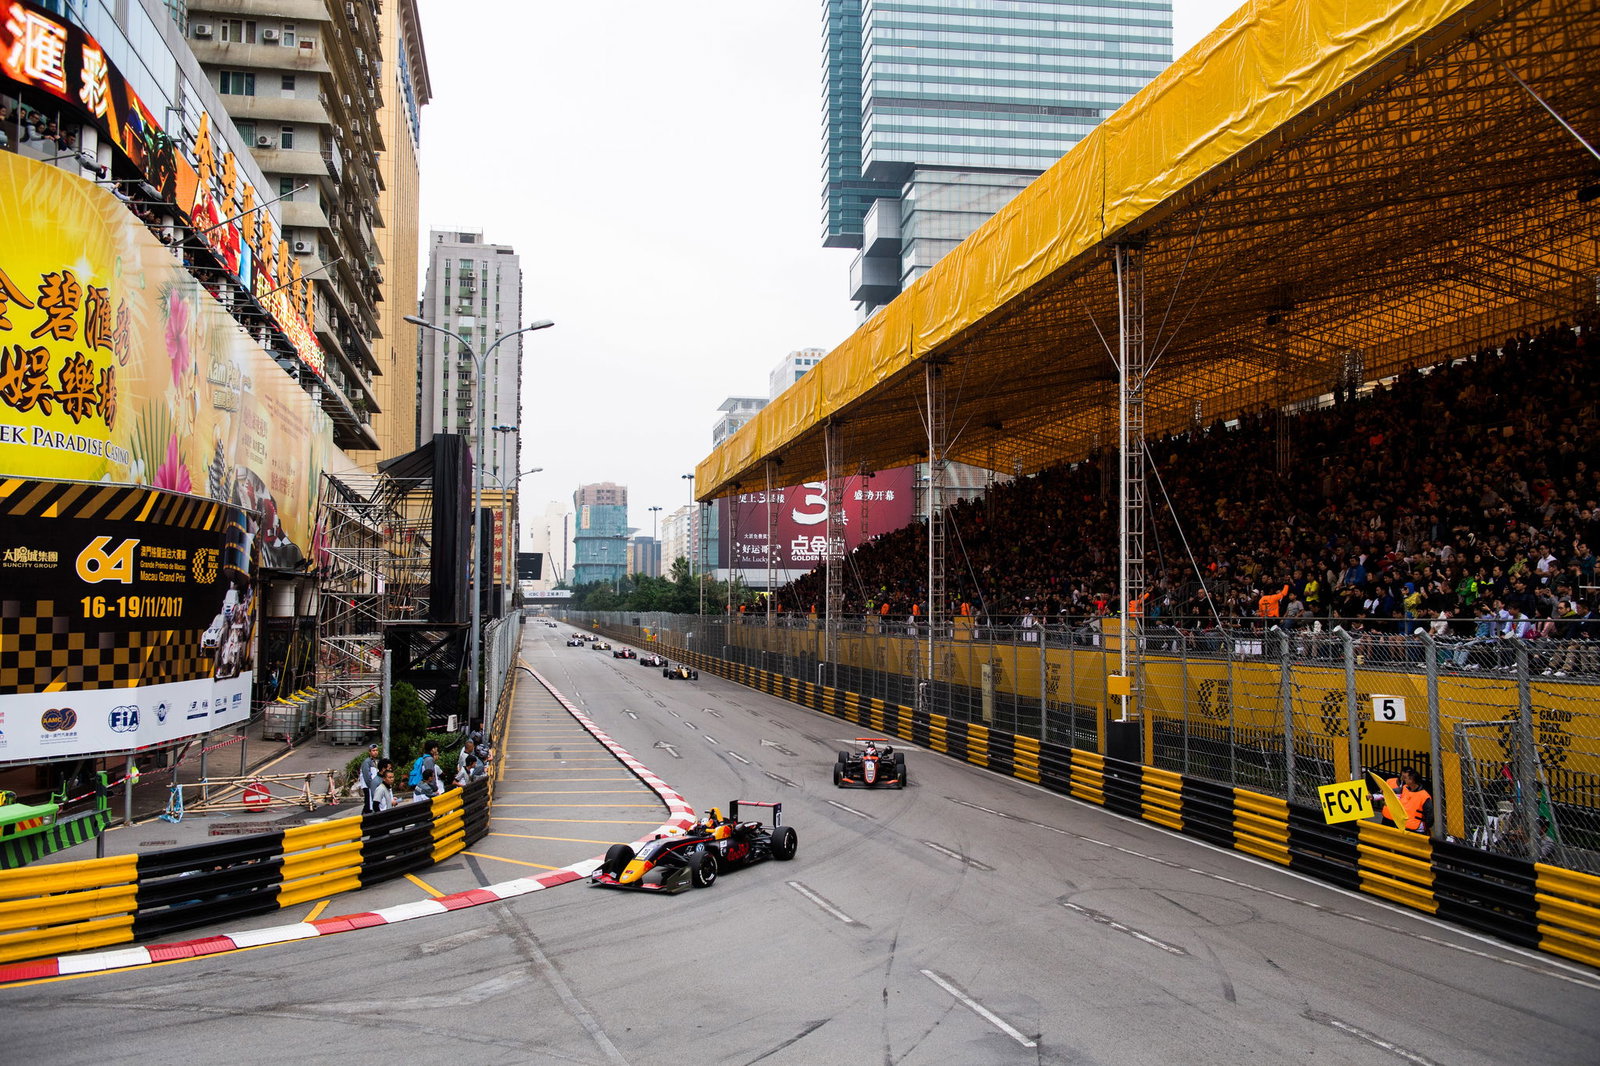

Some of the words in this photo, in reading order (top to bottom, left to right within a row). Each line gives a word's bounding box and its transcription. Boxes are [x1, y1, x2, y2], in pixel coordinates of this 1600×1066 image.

[0, 343, 118, 432] 娛樂場
[75, 536, 141, 584] 64
[140, 570, 158, 581] Macau
[159, 571, 175, 582] Grand
[175, 573, 186, 583] Prix
[1383, 699, 1396, 720] 5
[1539, 710, 1572, 722] GRAND
[1539, 721, 1561, 733] PRIX
[1539, 733, 1572, 746] MACAU
[1325, 788, 1366, 816] FCY
